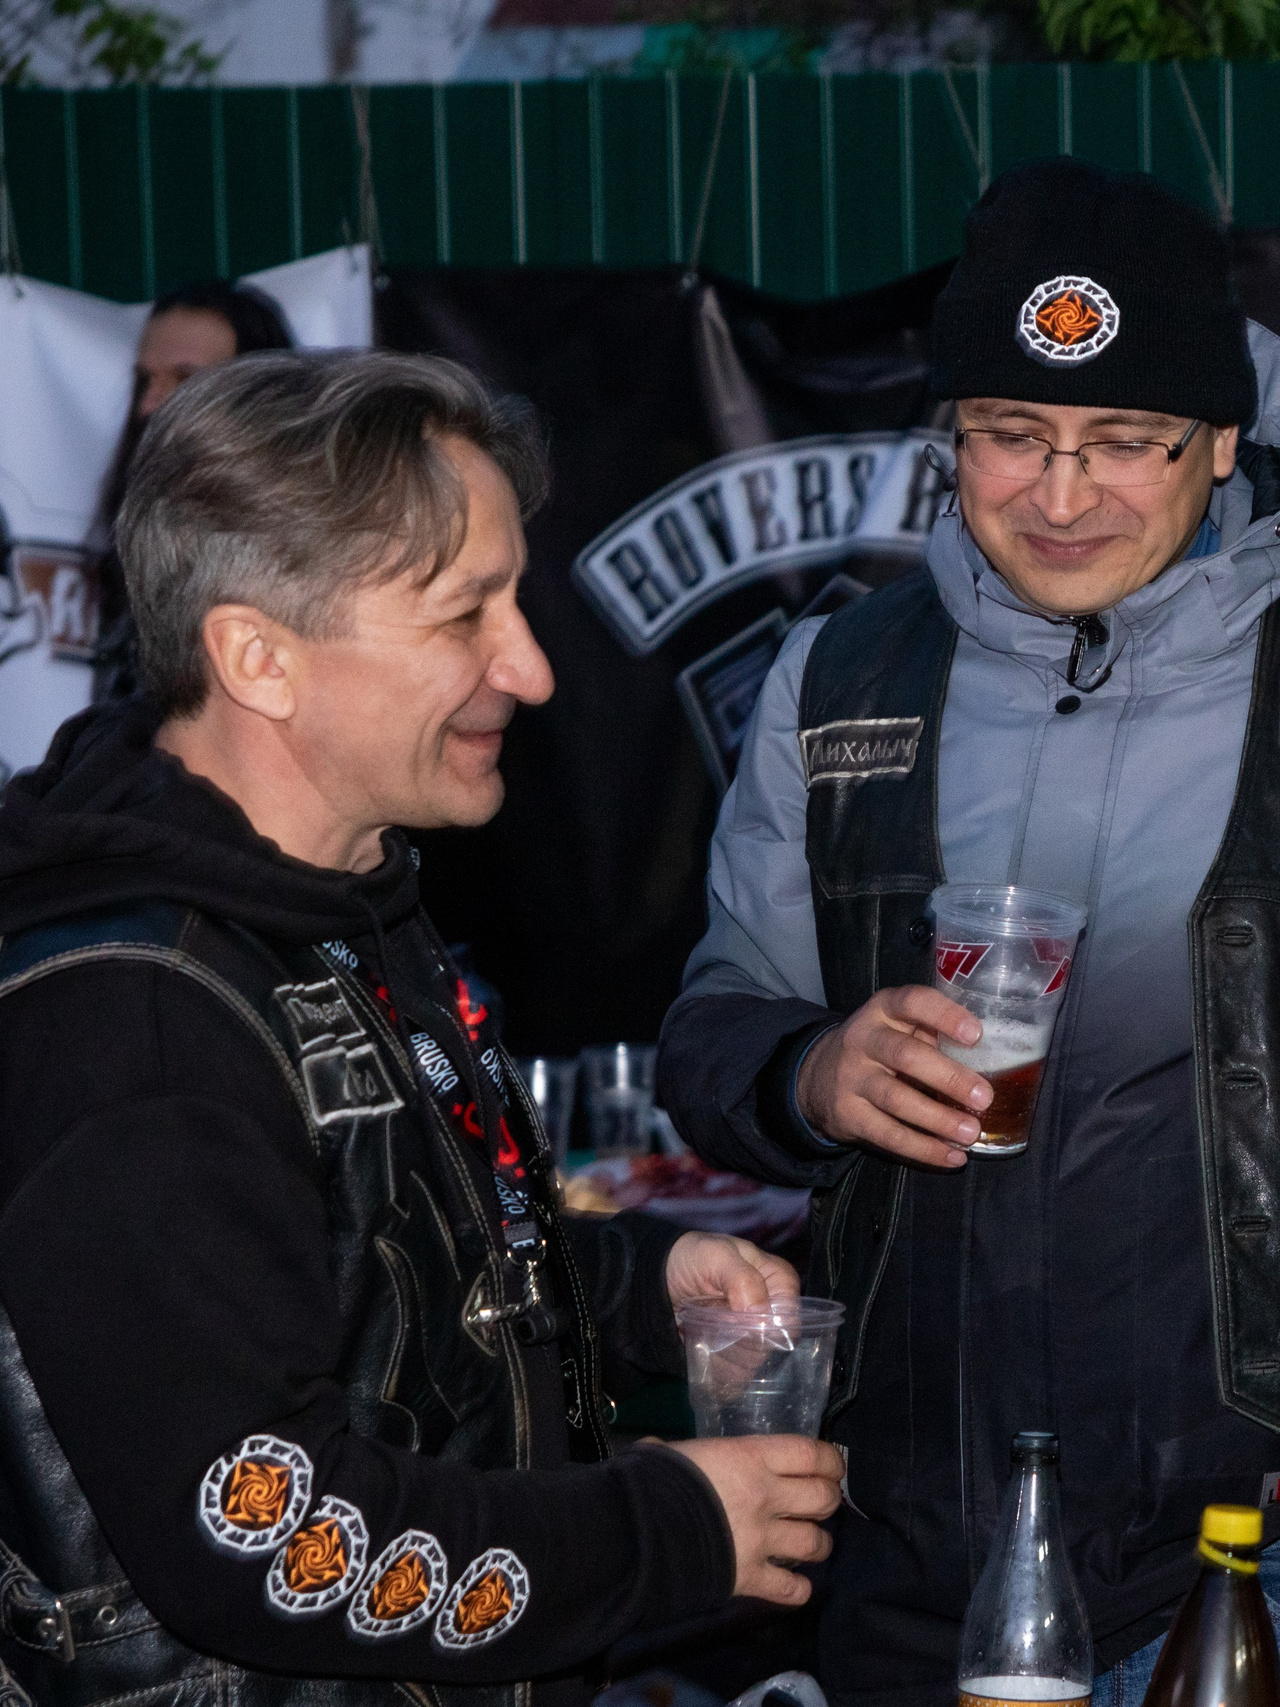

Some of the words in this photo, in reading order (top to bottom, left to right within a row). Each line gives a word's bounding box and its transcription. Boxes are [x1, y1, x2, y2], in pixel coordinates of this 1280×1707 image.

[605, 451, 879, 623] ROVERS
[808, 738, 914, 773] Михалыч
[409, 1031, 460, 1094] BRUSKO
